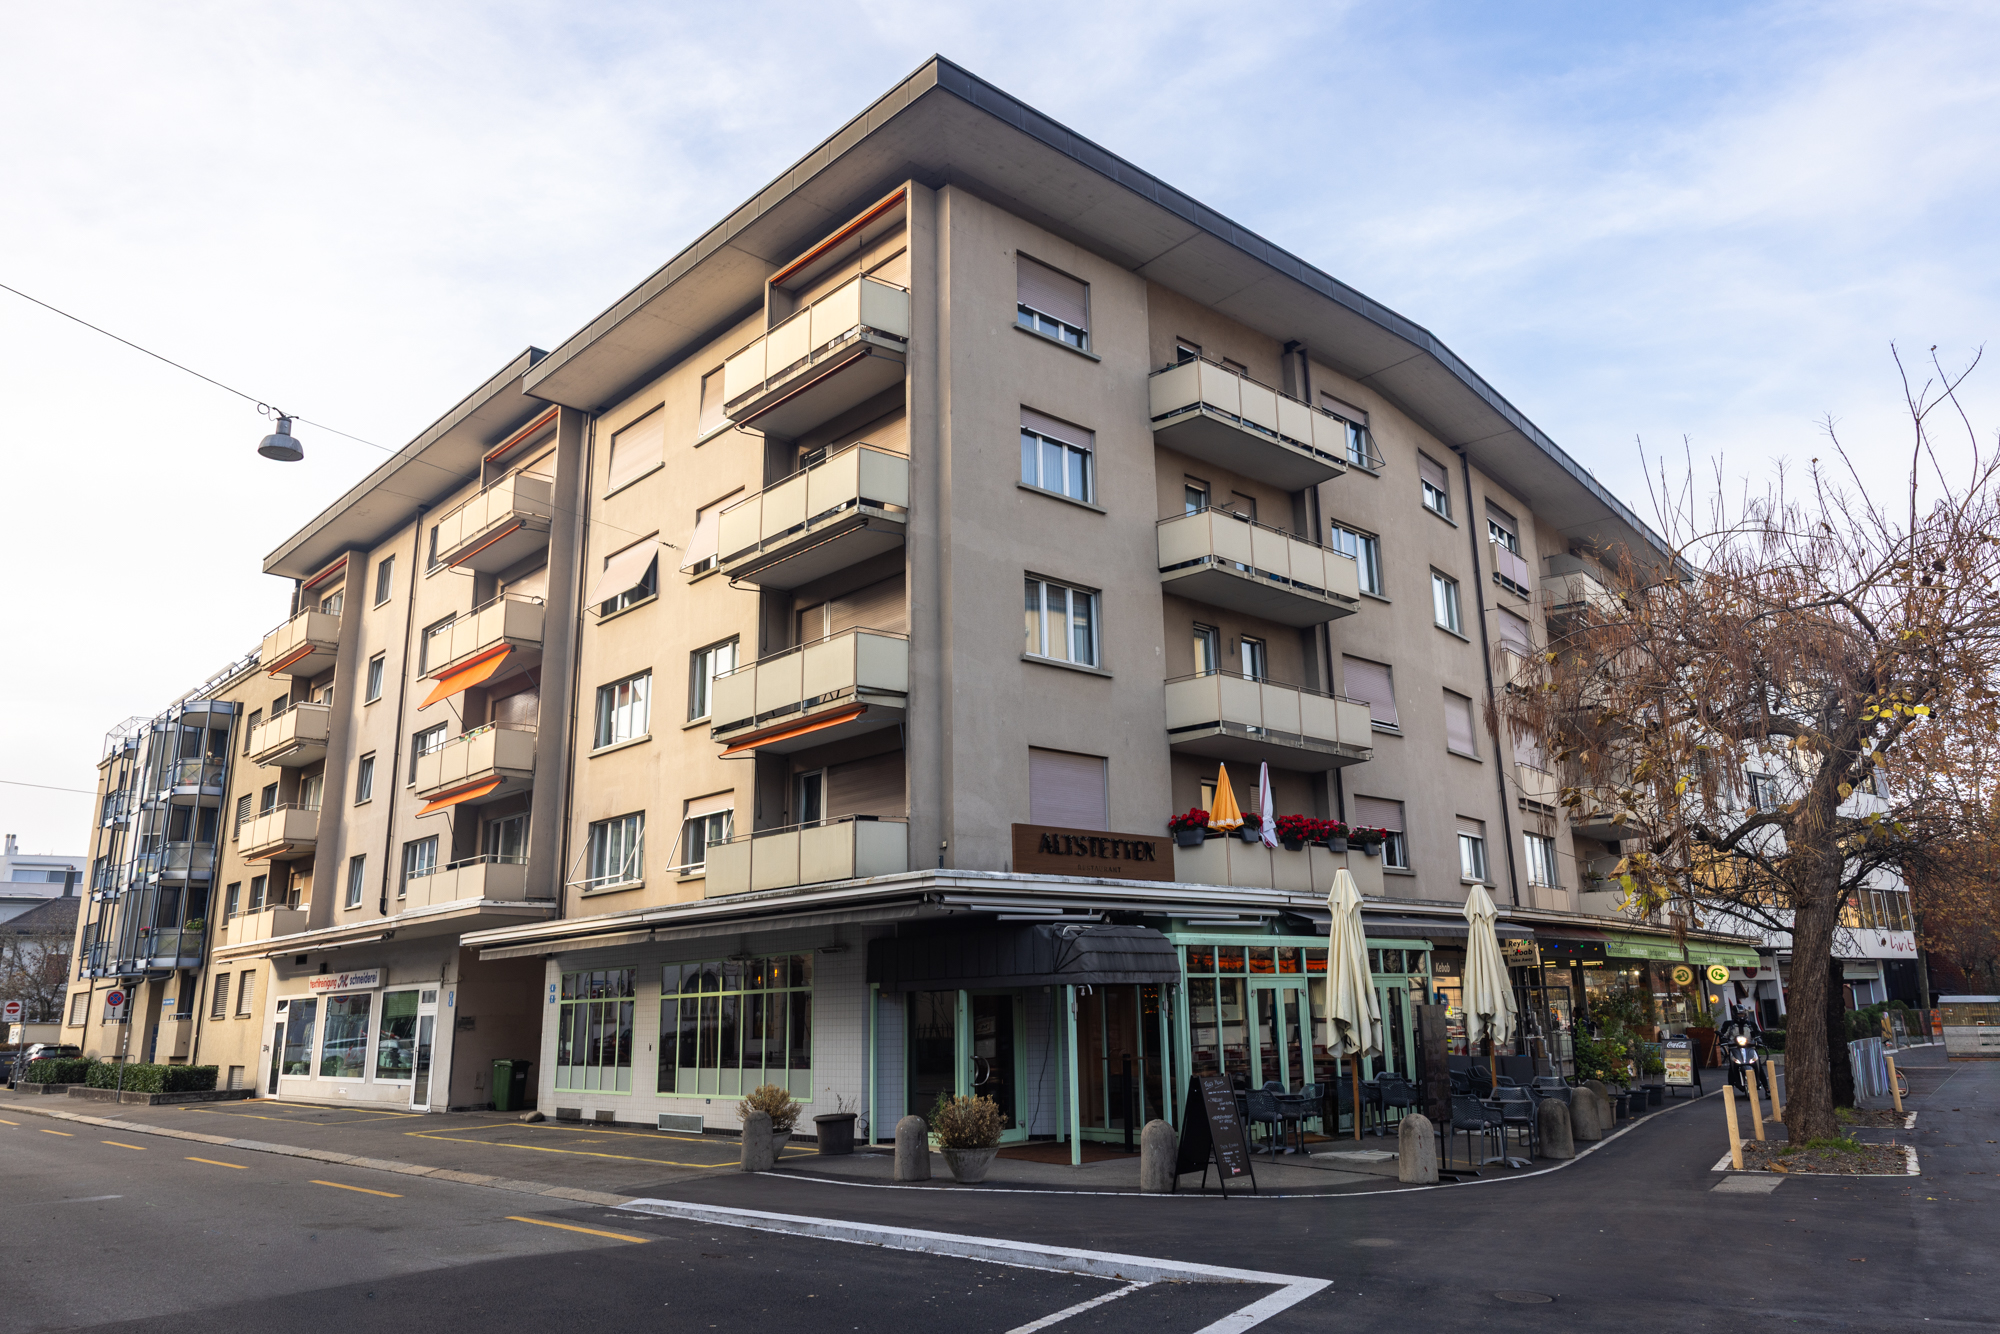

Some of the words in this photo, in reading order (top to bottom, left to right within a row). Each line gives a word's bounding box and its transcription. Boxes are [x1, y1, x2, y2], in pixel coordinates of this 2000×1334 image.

[1039, 832, 1157, 862] ALTSTETTEN
[1077, 863, 1121, 873] RESTAURANT
[1889, 934, 1916, 952] livit
[1435, 962, 1451, 973] Kebab
[349, 971, 378, 985] schneiderei
[1666, 1041, 1688, 1049] Coca-Cola
